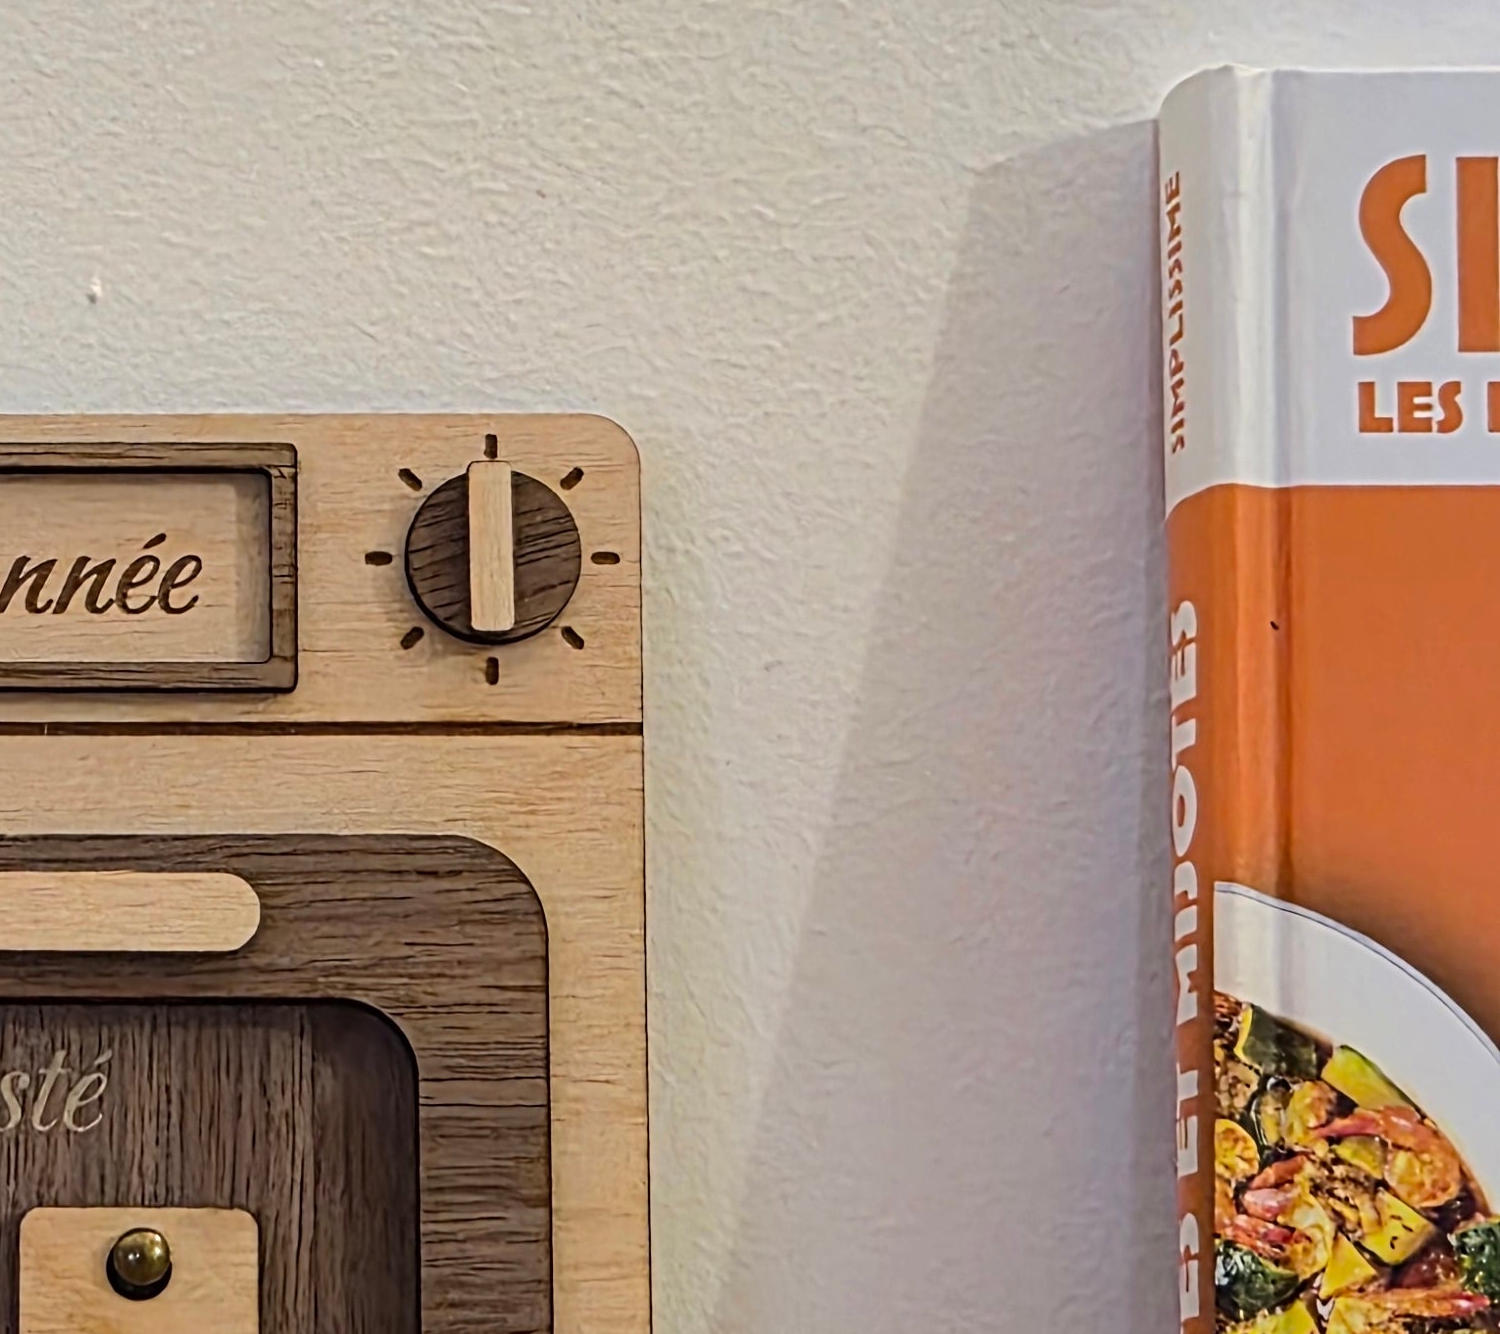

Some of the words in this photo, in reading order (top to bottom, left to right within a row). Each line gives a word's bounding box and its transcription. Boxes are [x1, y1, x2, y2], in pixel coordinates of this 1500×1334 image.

[1164, 171, 1185, 455] SIMPLISSIME
[1358, 380, 1463, 434] LES
[1176, 1064, 1200, 1176] ET
